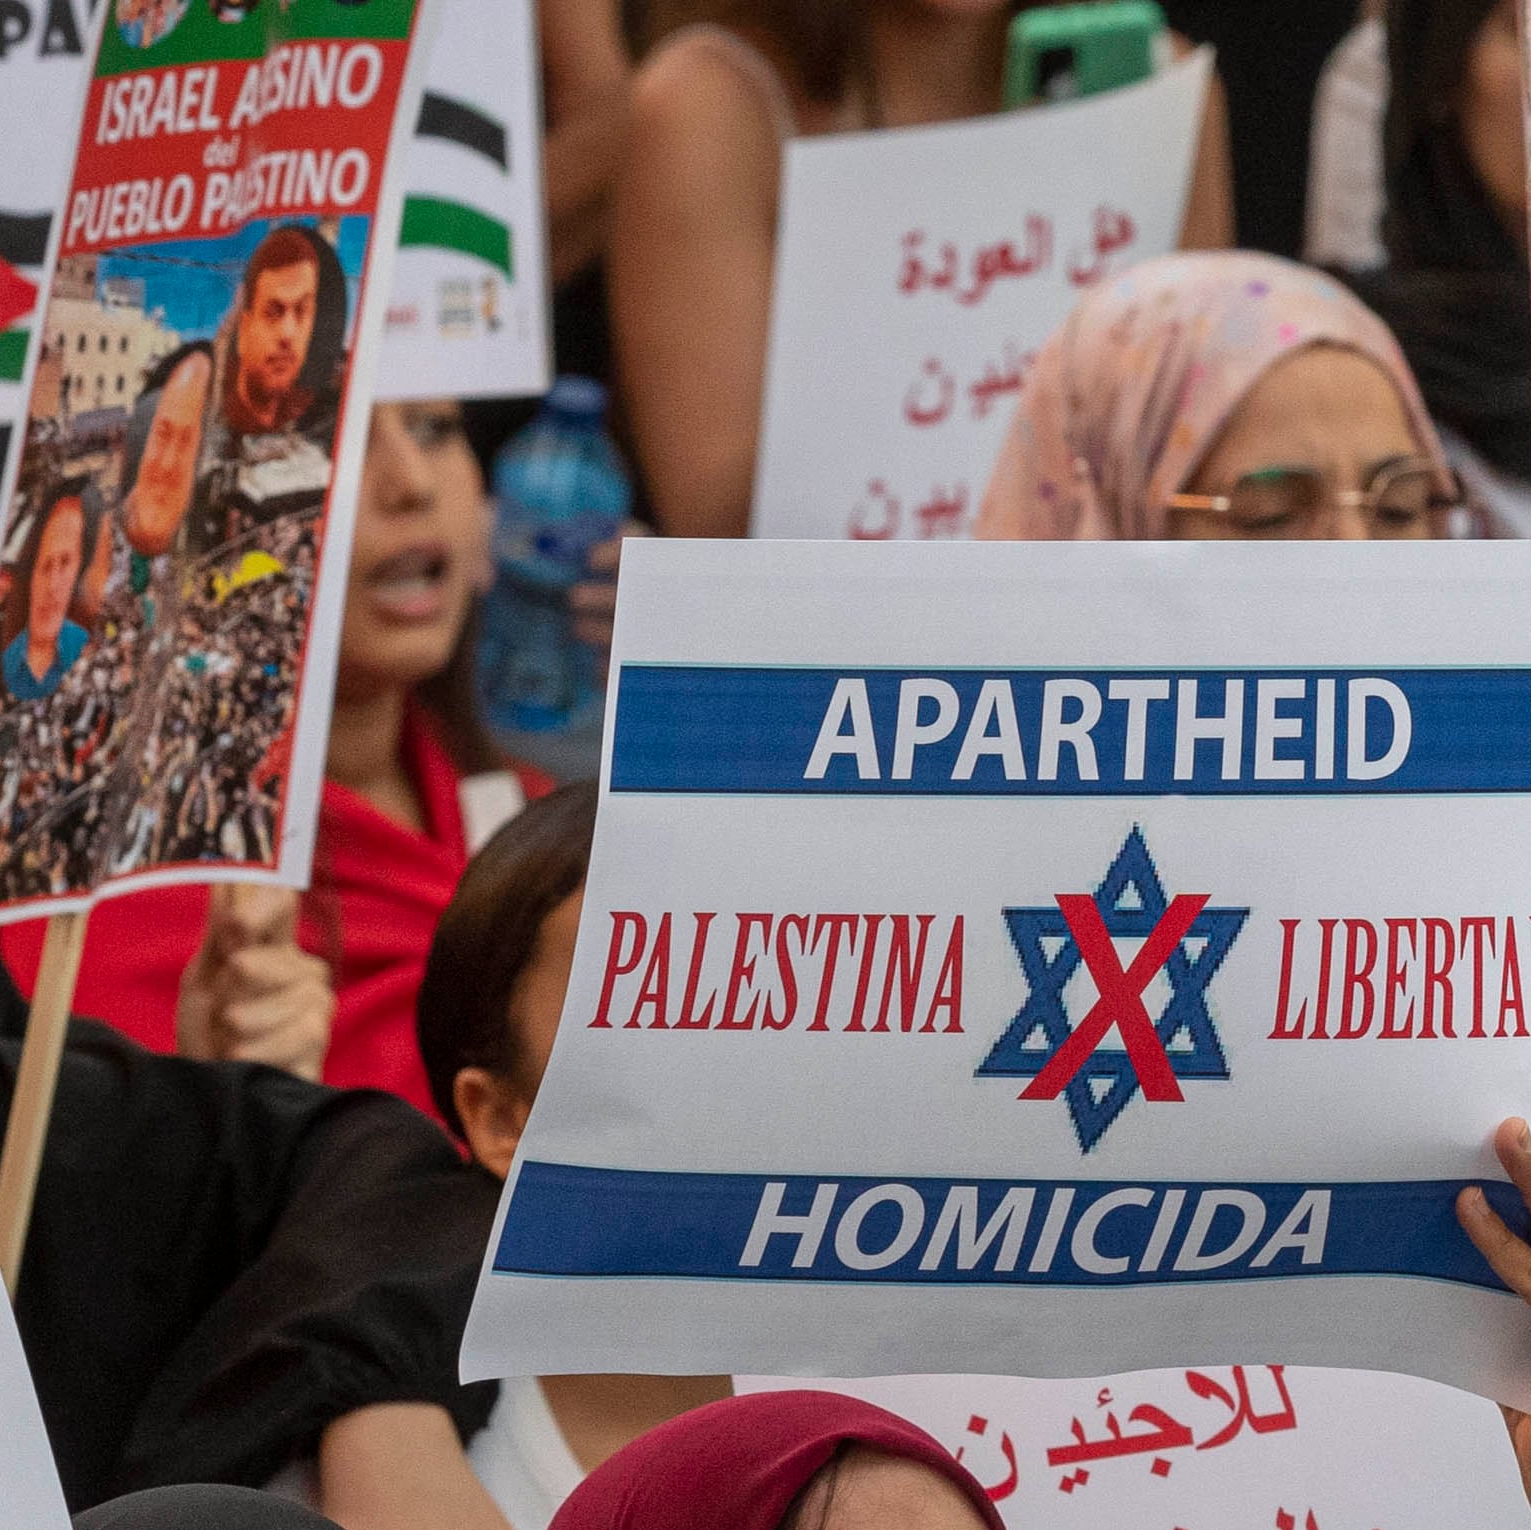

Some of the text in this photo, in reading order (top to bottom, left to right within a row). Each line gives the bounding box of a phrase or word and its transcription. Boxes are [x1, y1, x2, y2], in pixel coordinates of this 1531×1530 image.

[96, 66, 221, 144] ISRAEL
[203, 135, 240, 166] del
[66, 174, 194, 247] PUEBLO
[802, 676, 1413, 782] APARTHEID
[589, 910, 966, 1034] PALESTINA
[737, 1180, 1332, 1275] HOMICIDA
